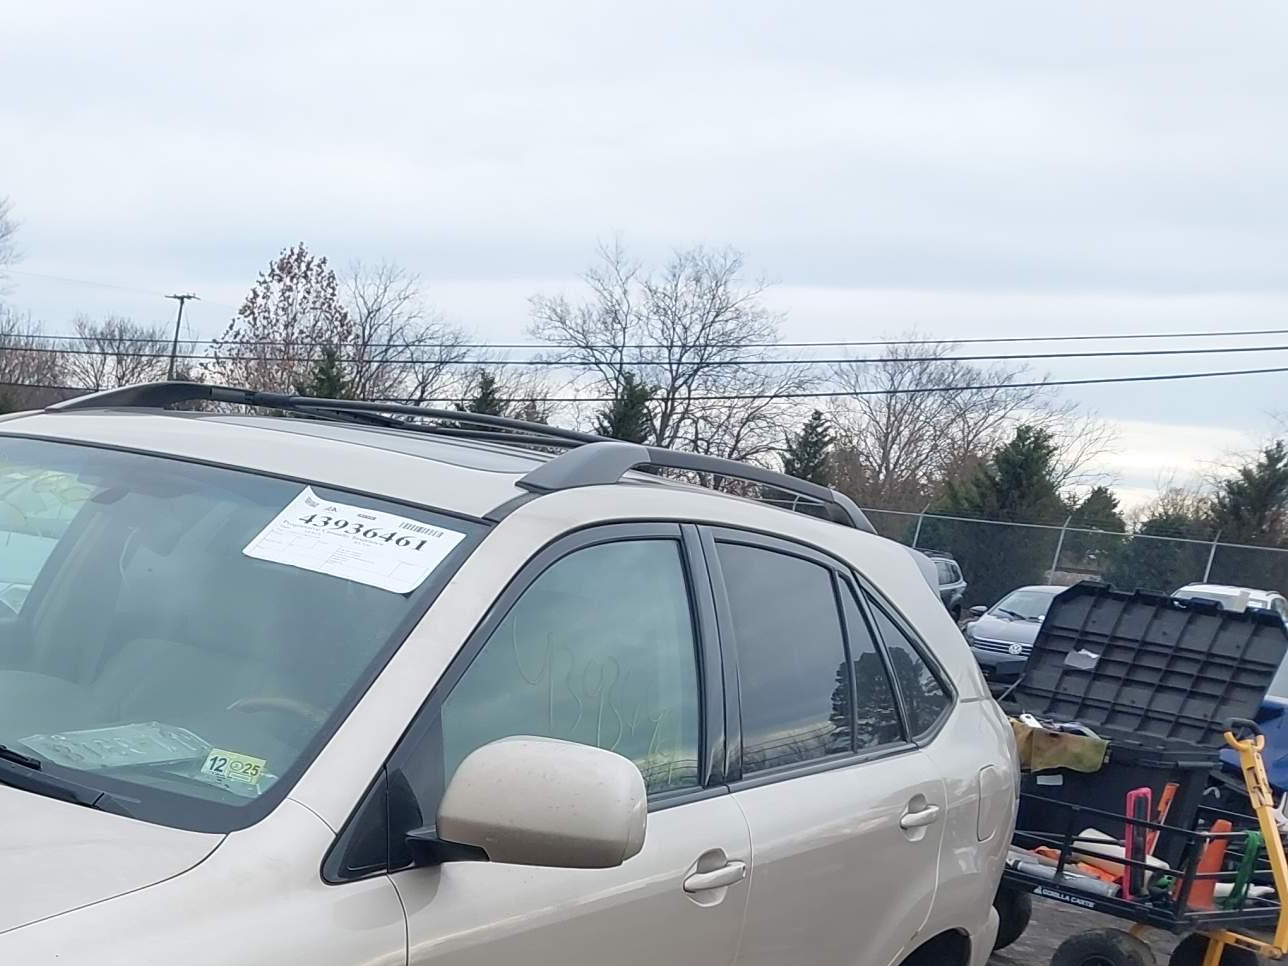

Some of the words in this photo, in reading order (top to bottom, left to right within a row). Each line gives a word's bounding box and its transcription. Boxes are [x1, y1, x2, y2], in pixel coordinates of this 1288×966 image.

[298, 513, 428, 551] 43936461
[209, 756, 228, 773] 12
[242, 762, 261, 777] 25
